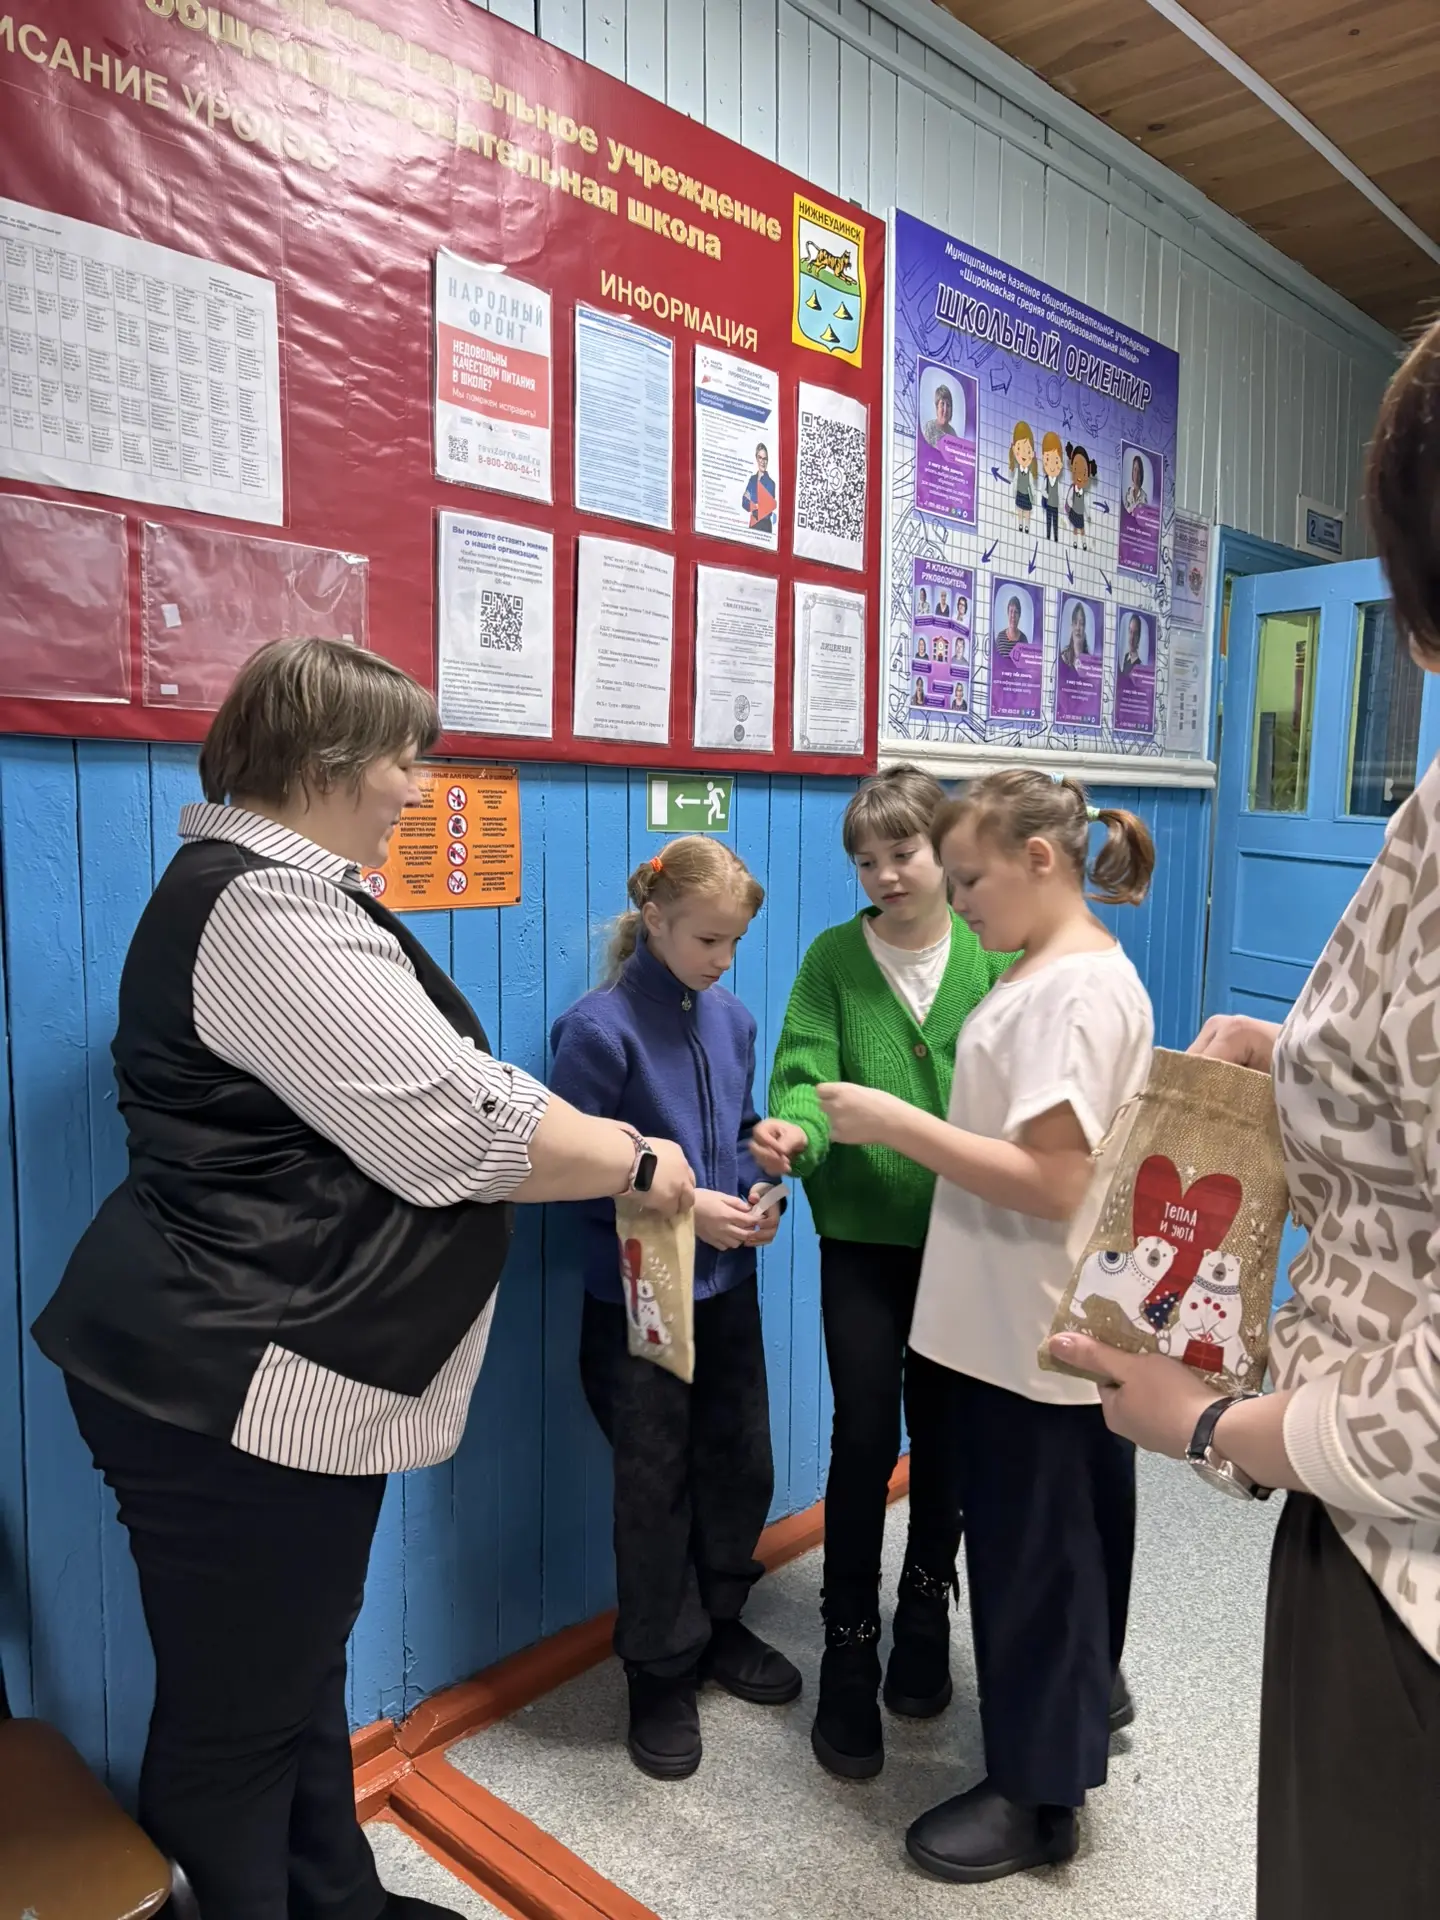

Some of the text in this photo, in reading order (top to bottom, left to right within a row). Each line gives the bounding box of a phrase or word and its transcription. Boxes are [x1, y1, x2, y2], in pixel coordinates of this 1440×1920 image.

[181, 84, 338, 172] УРОКОВ
[607, 135, 782, 243] учреждение
[628, 197, 722, 261] школа
[799, 201, 861, 242] НИЖНЕУДИНСК
[448, 277, 543, 328] НАРОДНЫЙ
[601, 270, 758, 353] ИНФОРМАЦИЯ
[945, 241, 1150, 356] Муниципальное казенное общеобразовательное учреждение
[960, 268, 1015, 303] «Широковская
[1016, 296, 1045, 318] средняя
[1046, 311, 1118, 354] общеобразовательная
[469, 308, 526, 343] ФРОНТ
[453, 340, 507, 368] НЕДОВОЛЬНЫ
[935, 282, 1153, 412] ШКОЛЬНЫЙ ОРИЕНТИР
[453, 355, 536, 392] КАЧЕСТВОМ ПИТАНИЯ
[453, 370, 492, 393] В ШКОЛЕ?
[453, 388, 465, 399] Мы
[452, 526, 465, 535] Вы
[466, 529, 495, 540] можете
[497, 535, 526, 547] оставить
[471, 541, 497, 551] нашей
[921, 571, 967, 590] РУКОВОДИТЕЛЬ
[931, 563, 965, 578] КЛАССНЫЙ
[1171, 1223, 1195, 1243] УЮТА
